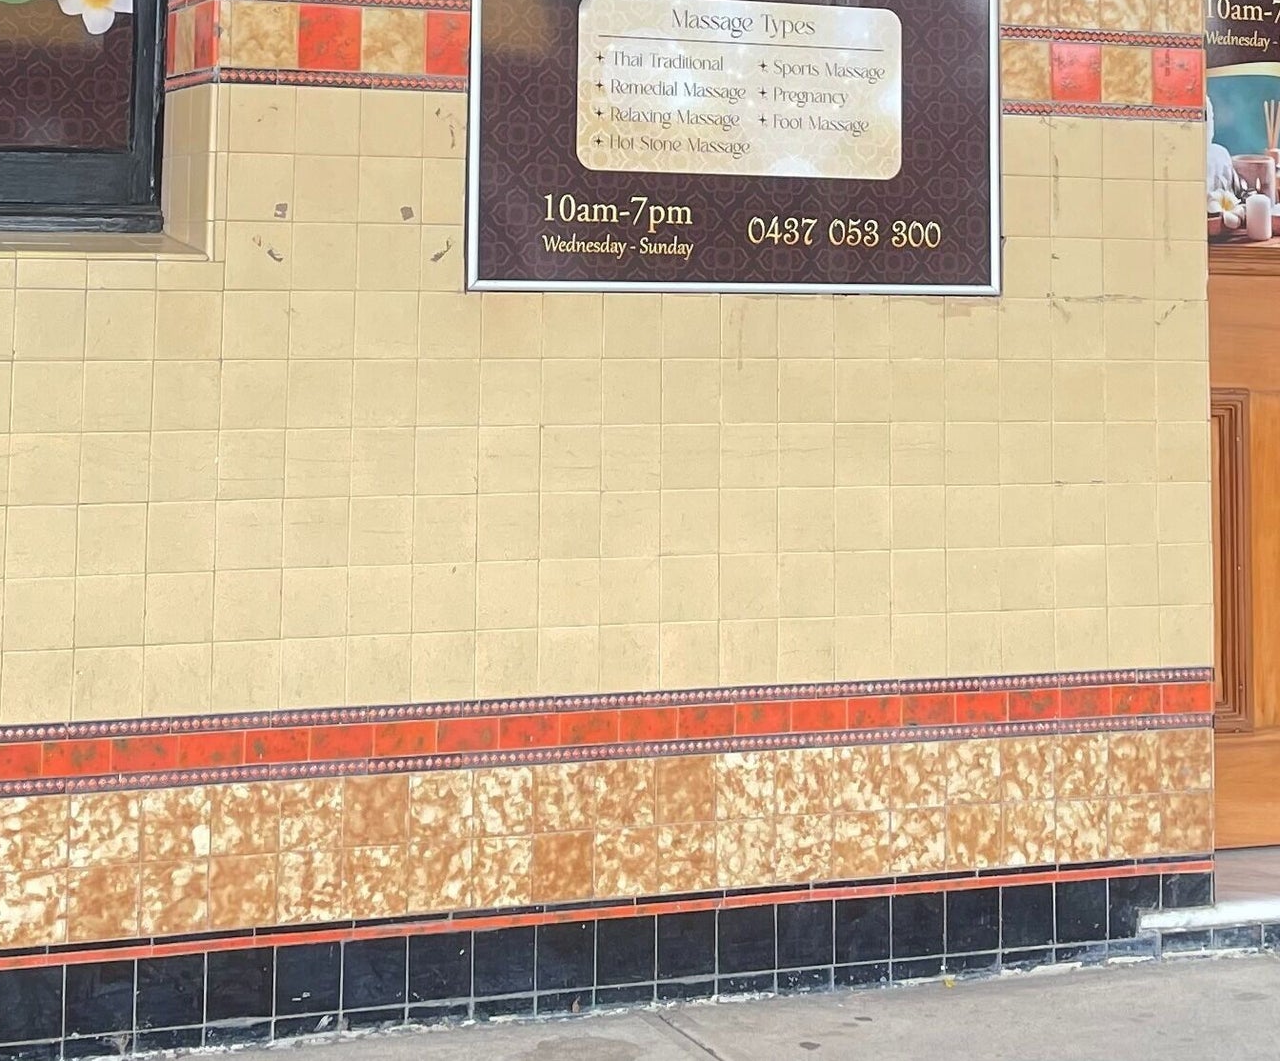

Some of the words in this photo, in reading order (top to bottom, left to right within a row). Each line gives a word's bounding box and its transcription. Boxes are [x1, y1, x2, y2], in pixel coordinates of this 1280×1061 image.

[672, 9, 754, 38] Massage
[760, 14, 817, 39] Types
[1205, 28, 1271, 53] Wednesday
[613, 50, 643, 67] Thai
[649, 52, 724, 72] Traditional
[773, 59, 820, 78] Sports
[824, 62, 886, 85] Massage
[610, 78, 678, 97] Remedial
[683, 81, 747, 105] Massage
[773, 86, 849, 108] Pregnancy
[609, 106, 672, 130] Relaxing
[676, 109, 741, 132] Massage
[772, 114, 803, 130] Foot
[809, 115, 870, 138] Massage
[609, 134, 635, 150] Hot
[639, 135, 683, 152] Stone
[687, 137, 751, 160] Massage
[543, 193, 693, 233] 10am-7pm
[747, 215, 818, 245] 0437
[828, 218, 879, 248] 053
[891, 220, 942, 249] 300
[542, 234, 628, 260] Wednesday
[639, 237, 694, 261] Sunday
